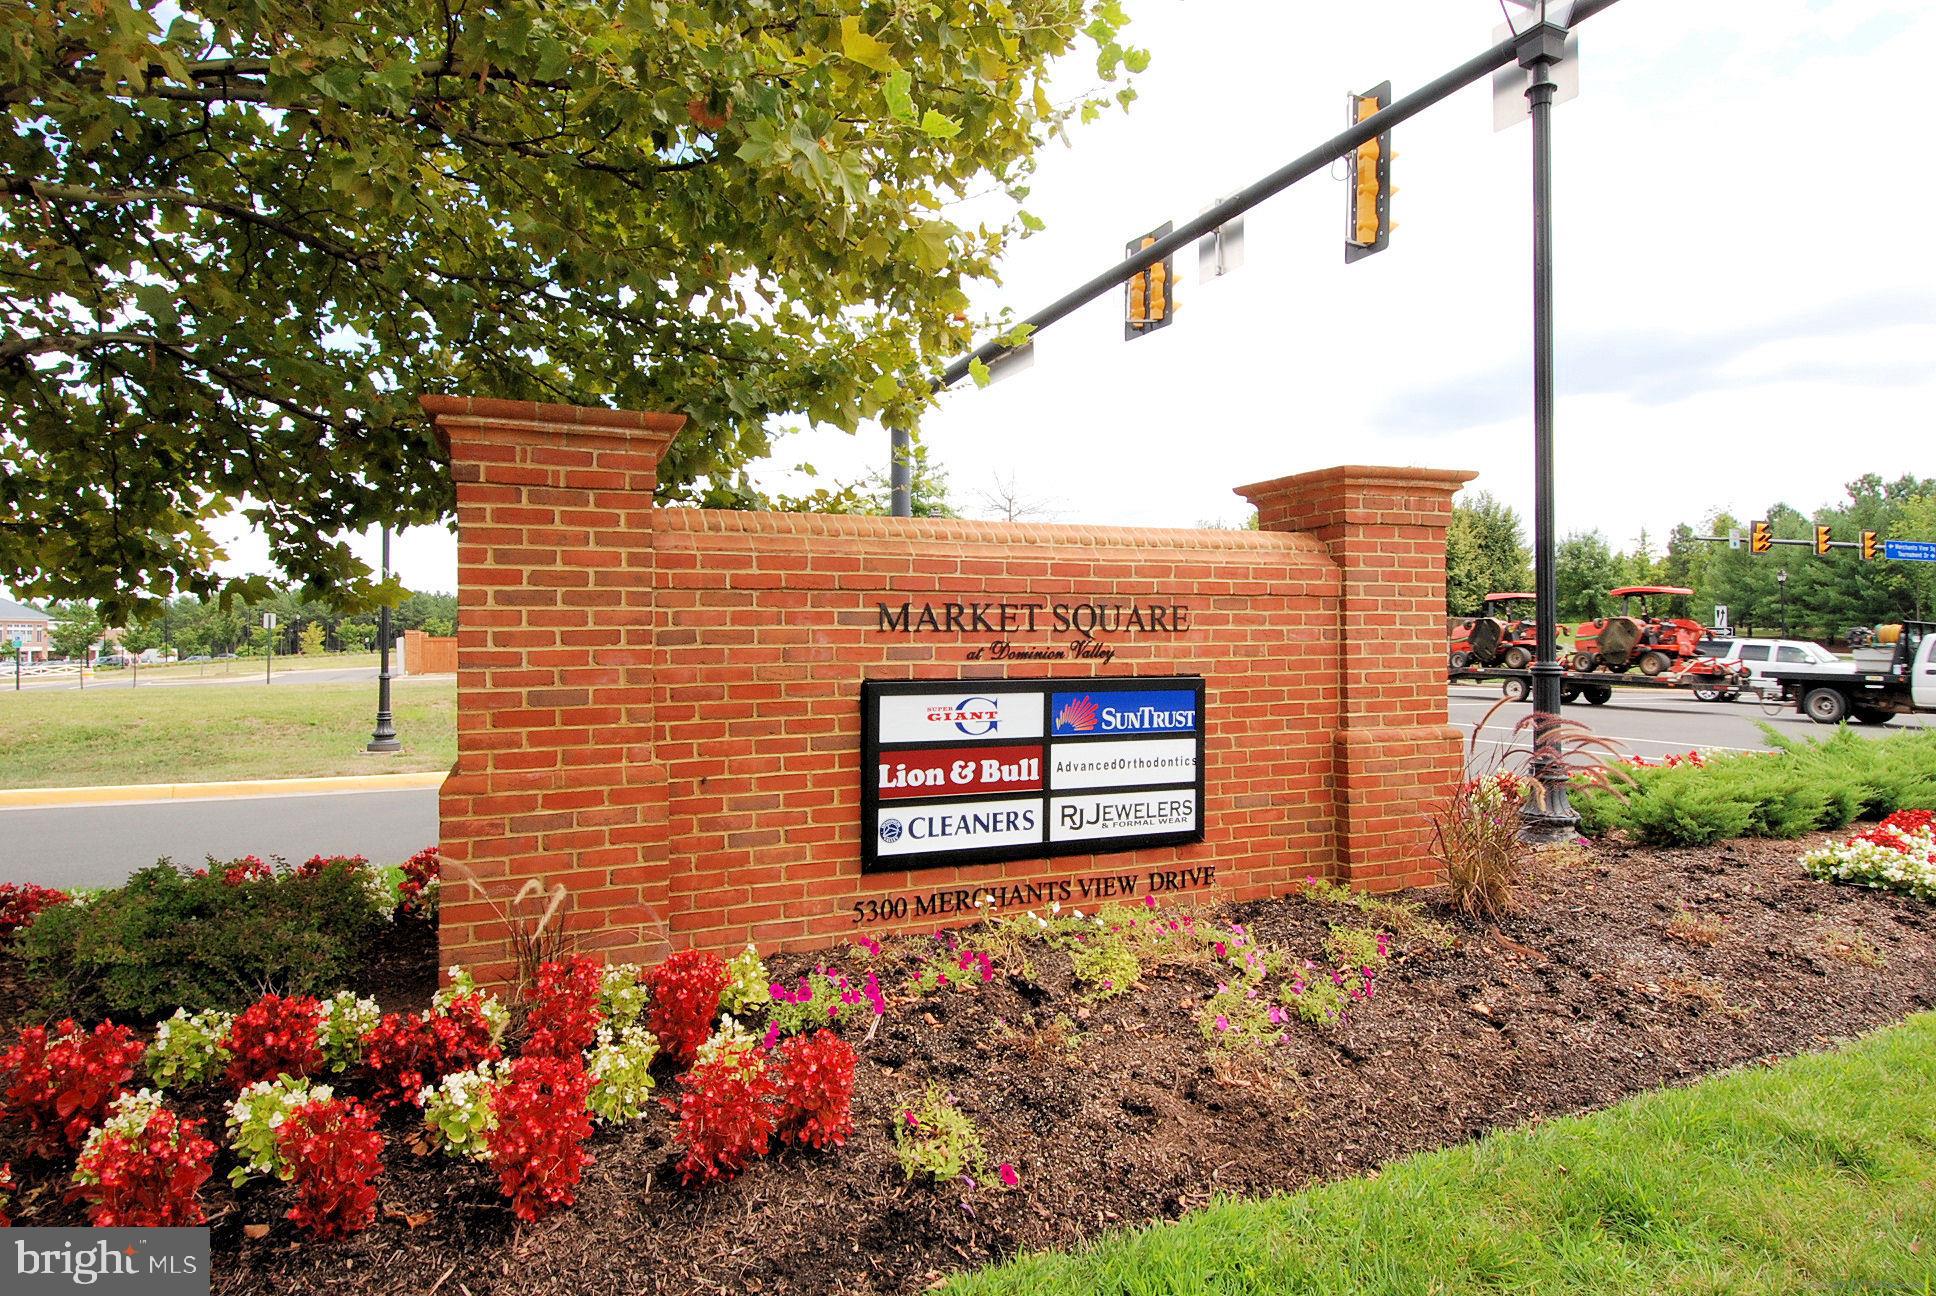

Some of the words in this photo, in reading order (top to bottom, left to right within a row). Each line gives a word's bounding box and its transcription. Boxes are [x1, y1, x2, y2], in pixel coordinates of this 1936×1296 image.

[876, 602, 1043, 633] MARKET
[1052, 603, 1190, 640] SQUARE
[966, 646, 985, 661] at
[989, 640, 1065, 661] Dominion
[1070, 639, 1115, 665] Valley
[927, 711, 998, 722] GIANT
[878, 763, 945, 788] Lion
[949, 760, 976, 784] &
[980, 757, 1040, 783] Bull
[908, 809, 1035, 840] CLEANERS
[1060, 804, 1084, 830] RJ
[1086, 799, 1193, 825] JEWELERS
[1112, 819, 1155, 828] FORMAL
[1158, 816, 1188, 825] WEAR
[852, 897, 908, 923] 5300
[914, 879, 1072, 916] MERCHANTS
[1078, 874, 1139, 898] VIEW
[1148, 866, 1215, 892] DRIVE
